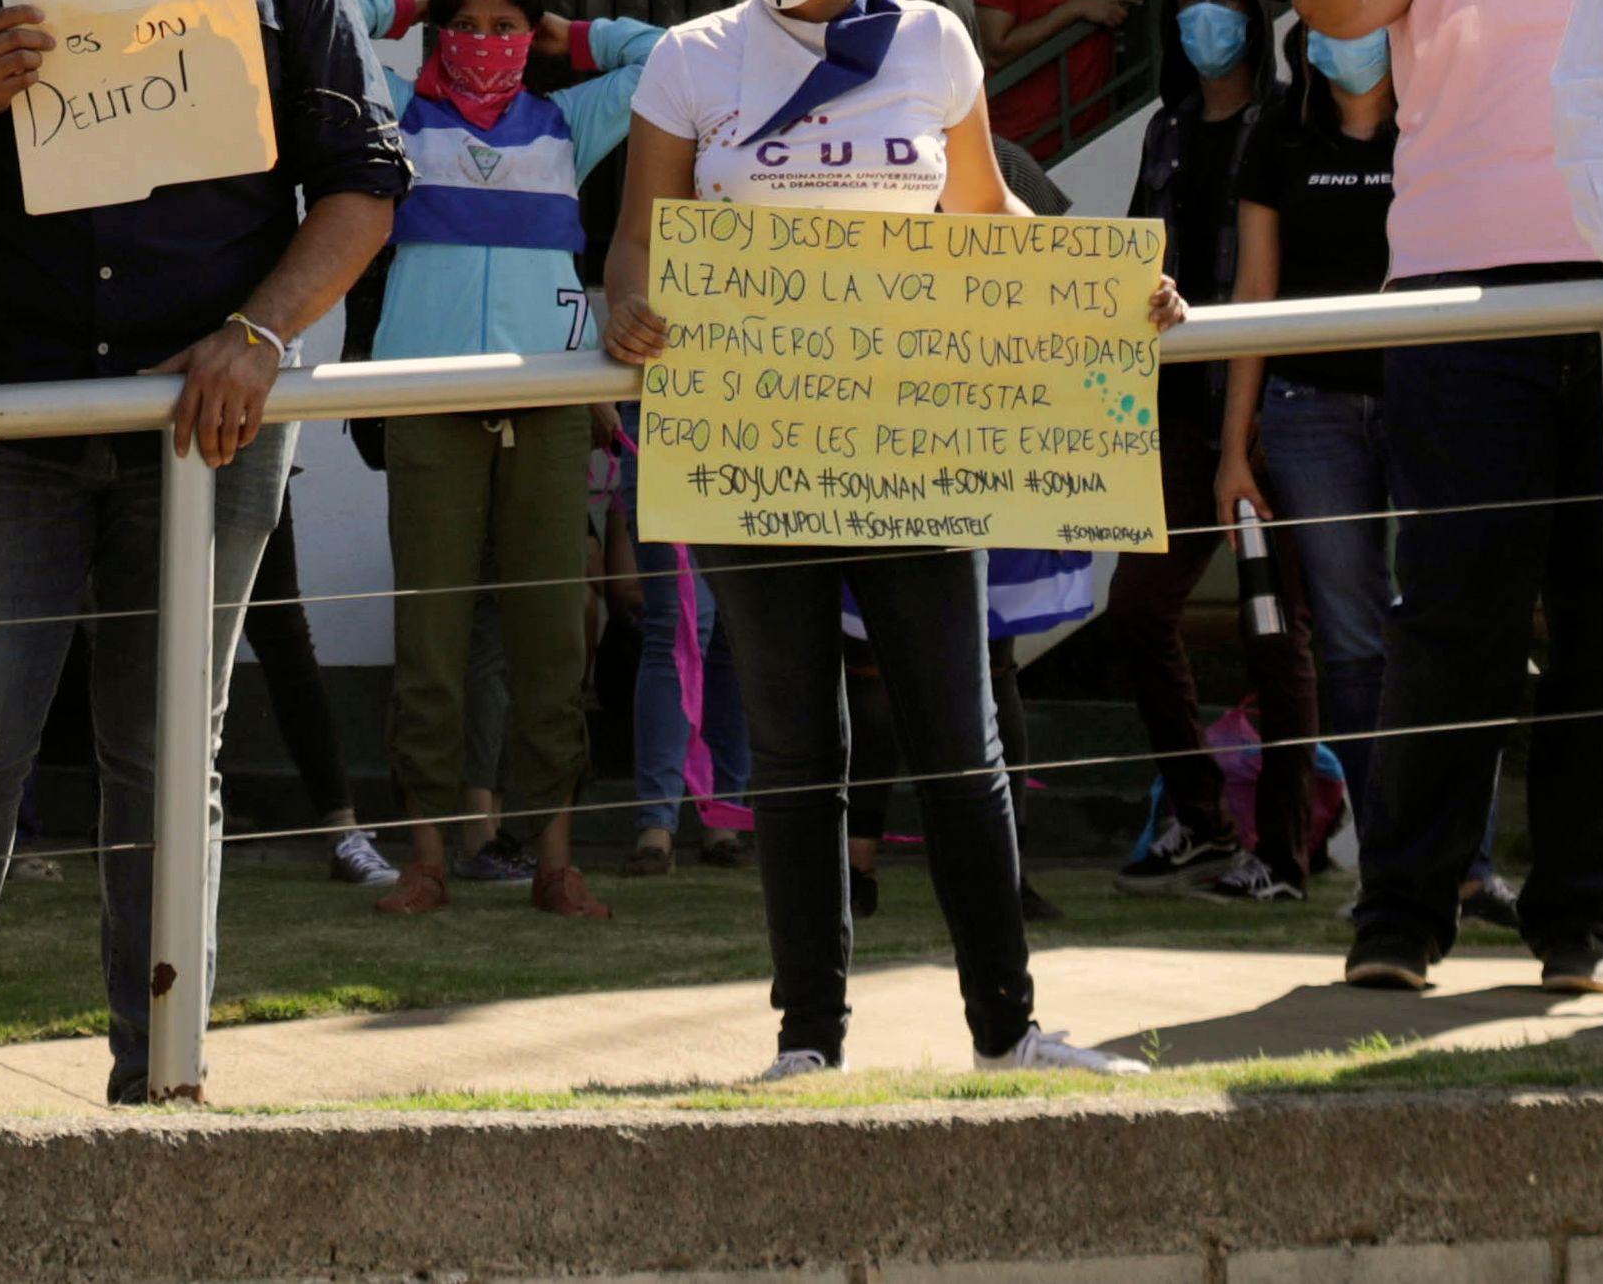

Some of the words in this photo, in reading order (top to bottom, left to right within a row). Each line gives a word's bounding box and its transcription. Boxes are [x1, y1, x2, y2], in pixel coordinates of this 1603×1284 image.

[66, 32, 102, 56] es
[749, 172, 853, 182] COORDINADORA
[771, 182, 786, 190] LA
[789, 180, 868, 190] DEMOCRACIA
[1307, 174, 1359, 185] SEND
[1364, 174, 1394, 185] ME
[659, 205, 755, 251] ESTOY
[768, 212, 866, 251] DESDE
[882, 218, 935, 253] MI
[947, 221, 1161, 265] UNIVERSIDAD
[659, 258, 807, 307] ALZANDO
[822, 270, 862, 303] LA
[877, 272, 937, 302] VOZ
[965, 275, 1025, 308] POR
[1050, 277, 1121, 319] MIS
[557, 288, 589, 351] 7
[663, 315, 835, 361] OMPAÑEROS
[849, 325, 884, 361] DE
[897, 329, 972, 364] OTRAS
[980, 332, 1160, 377] UNIVERSIDADES
[645, 364, 706, 398] QUE
[722, 370, 742, 402] SI
[755, 368, 873, 402] QUIEREN
[896, 380, 1052, 411] PROTESTAR
[645, 411, 711, 452] PERO
[722, 418, 760, 452] NO
[770, 418, 805, 450] SE
[815, 424, 858, 458] LES
[875, 423, 1008, 458] PERMITE
[1019, 425, 1161, 458] EXPRESARSE
[687, 463, 812, 503] #SOYUCA
[817, 466, 927, 504] #SOYUNAN
